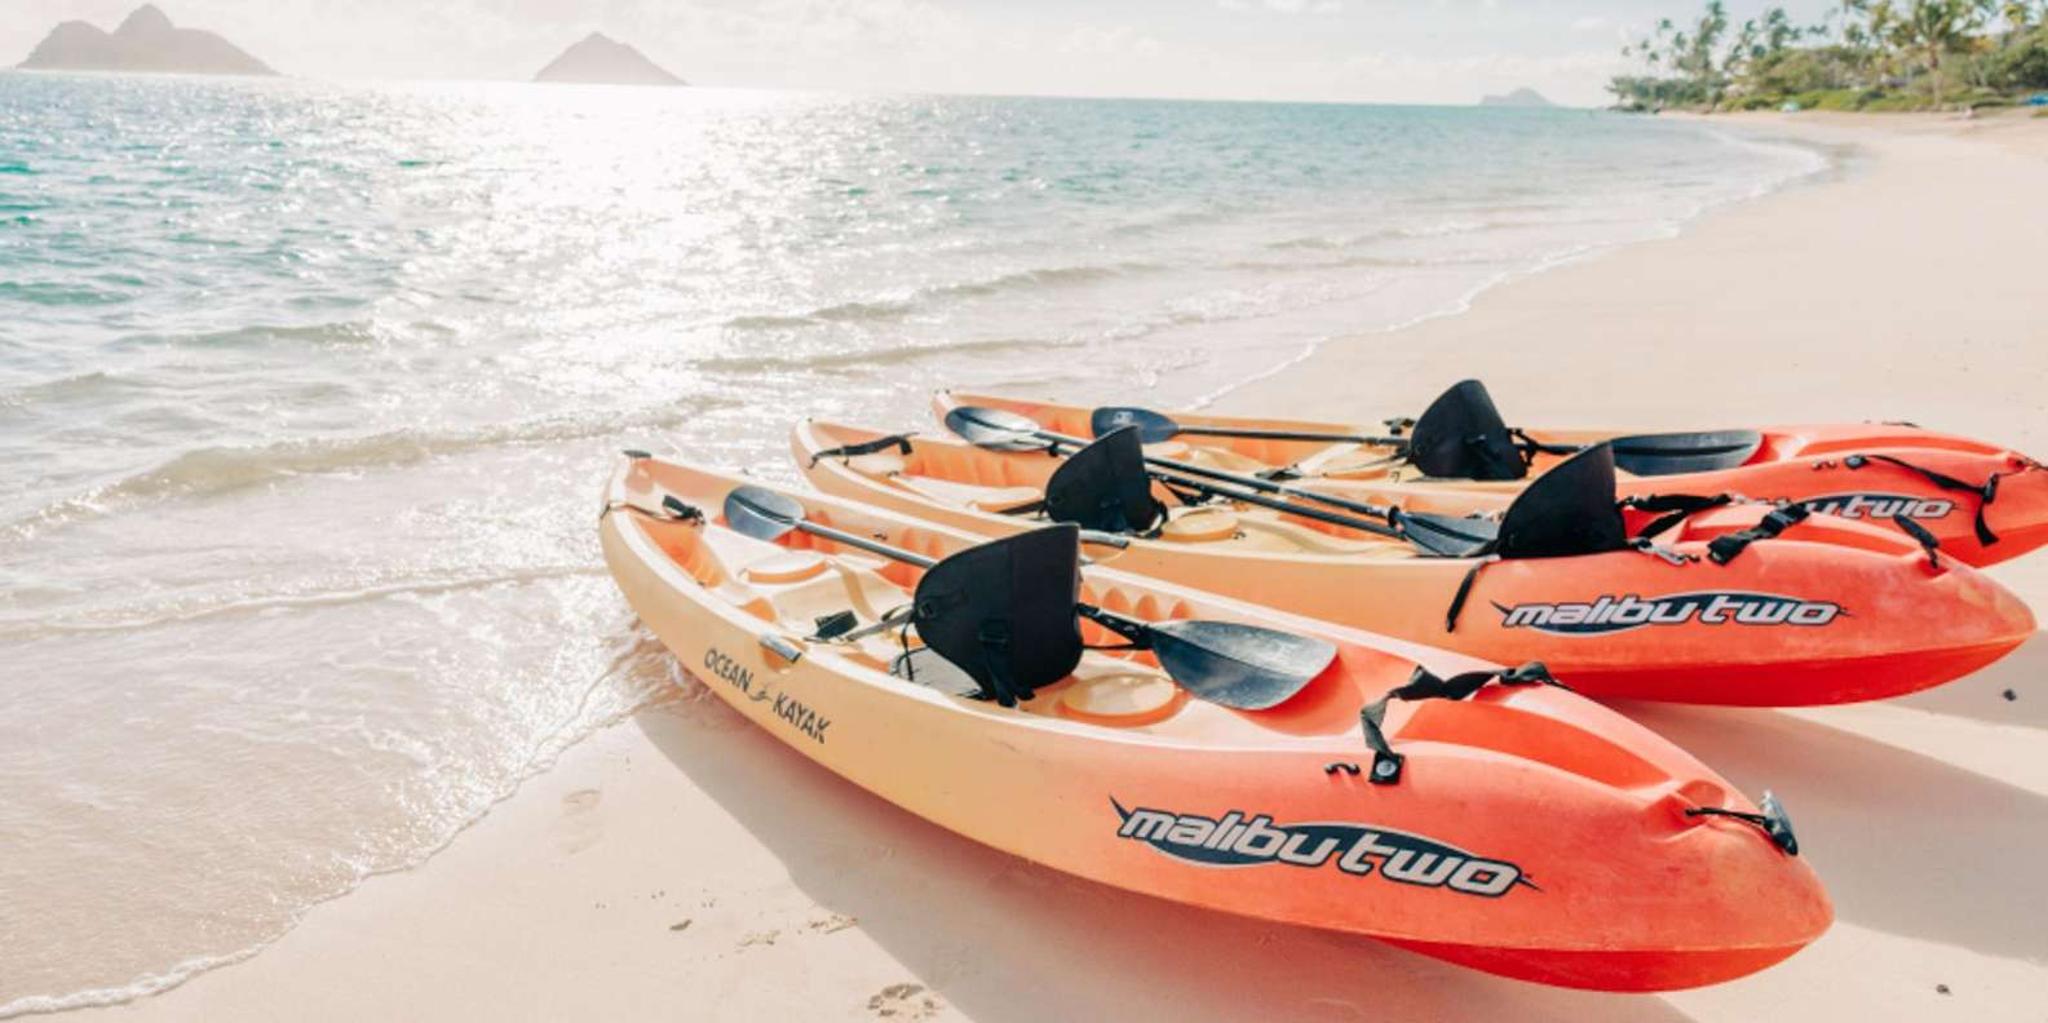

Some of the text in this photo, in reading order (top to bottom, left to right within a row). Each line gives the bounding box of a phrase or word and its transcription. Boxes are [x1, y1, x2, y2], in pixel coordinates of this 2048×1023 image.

[1840, 496, 1951, 518] two
[1503, 595, 1838, 625] malibu two
[704, 648, 831, 744] OCEAN KAYAK
[1119, 810, 1520, 897] malibu two
